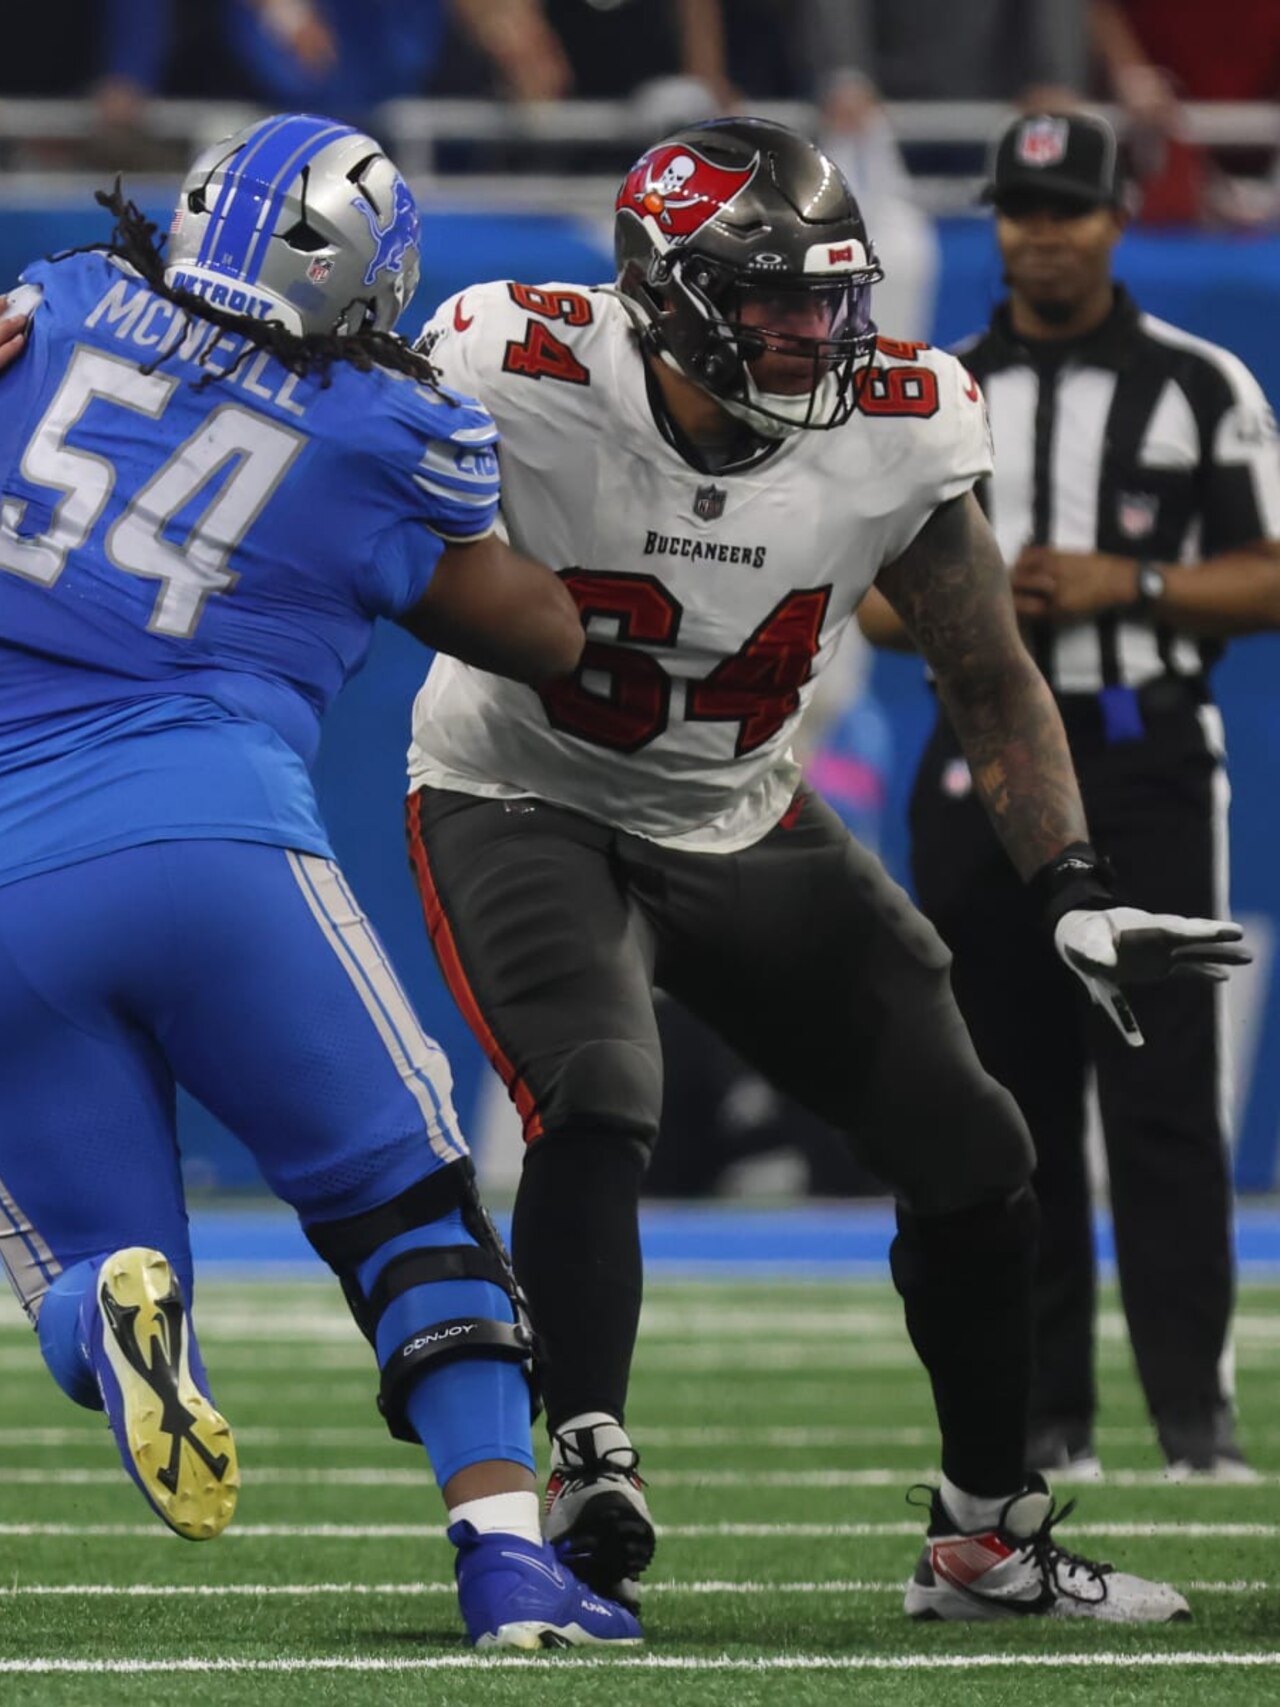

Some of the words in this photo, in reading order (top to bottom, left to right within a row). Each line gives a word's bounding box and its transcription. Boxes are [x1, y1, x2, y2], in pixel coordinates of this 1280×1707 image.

[172, 271, 274, 320] DETROIT
[84, 278, 306, 417] MCNEILL
[502, 283, 594, 387] 64
[643, 530, 767, 569] BUCCANEERS
[537, 566, 834, 759] 64
[403, 1324, 475, 1357] DONJOY
